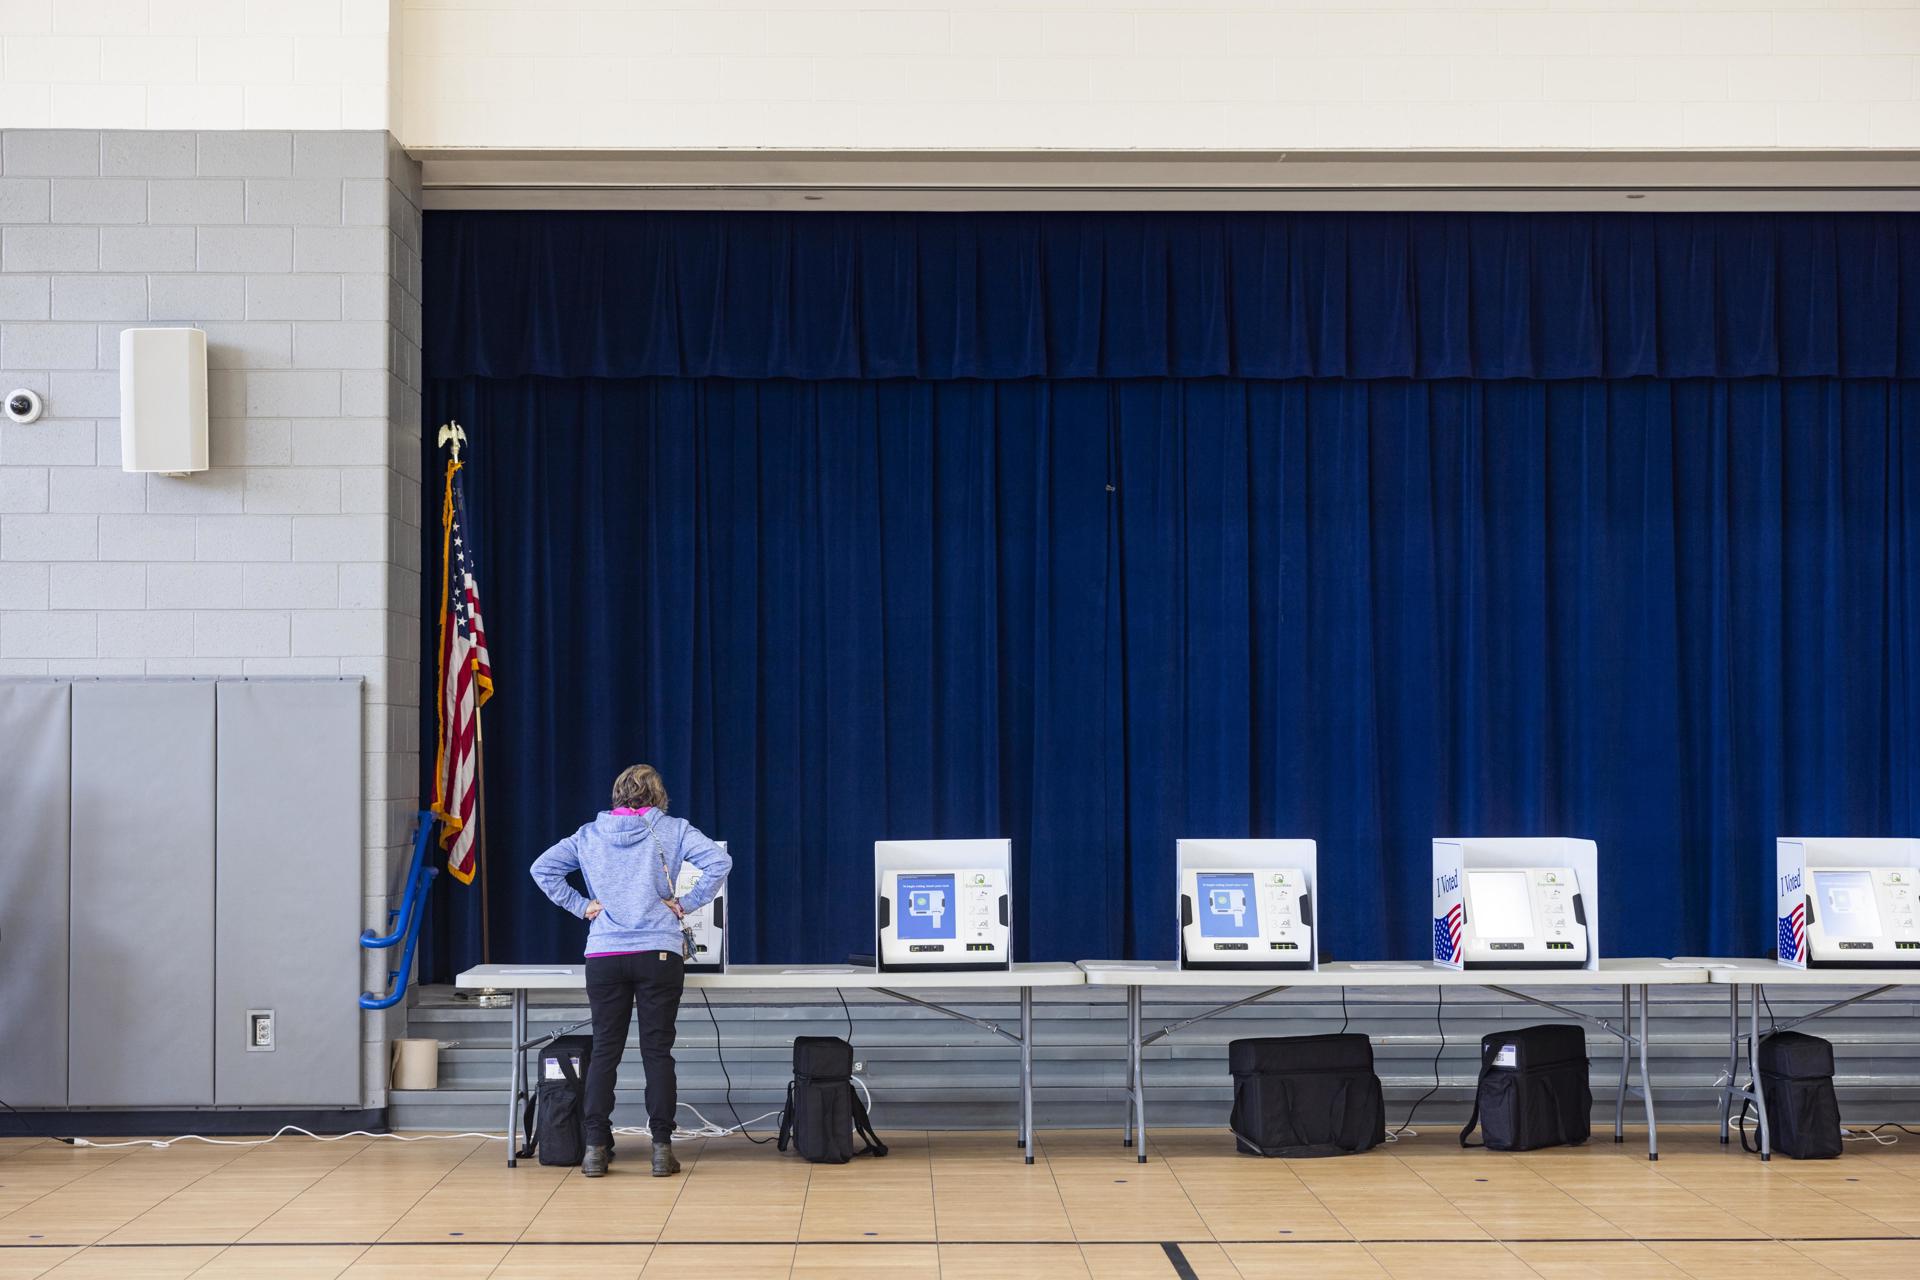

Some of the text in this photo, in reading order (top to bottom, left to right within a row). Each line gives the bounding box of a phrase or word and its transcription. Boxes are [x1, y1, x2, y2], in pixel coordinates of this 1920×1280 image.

[1437, 868, 1458, 898] I Voted
[1781, 868, 1801, 897] I Voted
